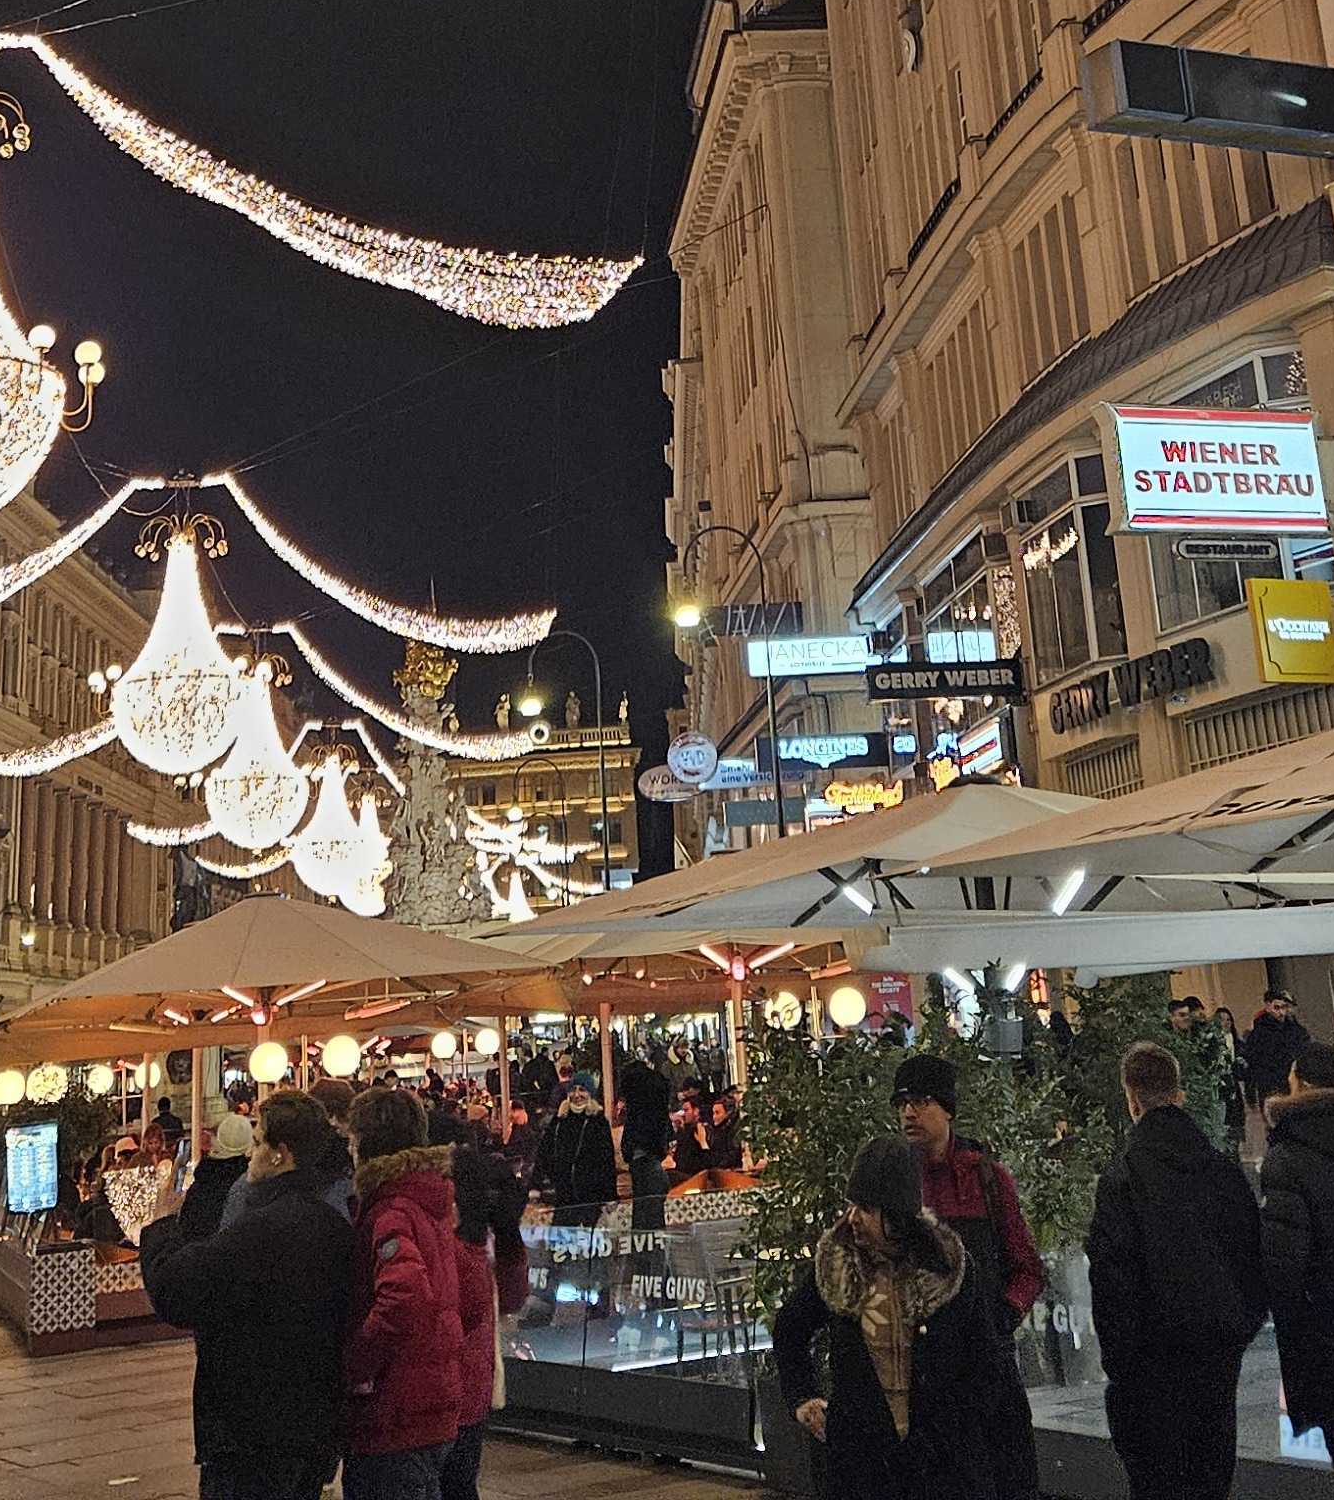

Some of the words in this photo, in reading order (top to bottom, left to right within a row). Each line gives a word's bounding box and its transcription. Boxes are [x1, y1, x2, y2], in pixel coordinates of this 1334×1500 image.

[1160, 440, 1280, 466] WIENER
[1134, 470, 1315, 497] STADTBRÄU
[875, 671, 940, 690] GERRY
[945, 668, 1015, 687] WEBER
[1111, 637, 1216, 708] WEBER
[778, 736, 868, 760] LONGINES
[632, 1275, 663, 1298] FIVE
[666, 1276, 707, 1301] GUYS
